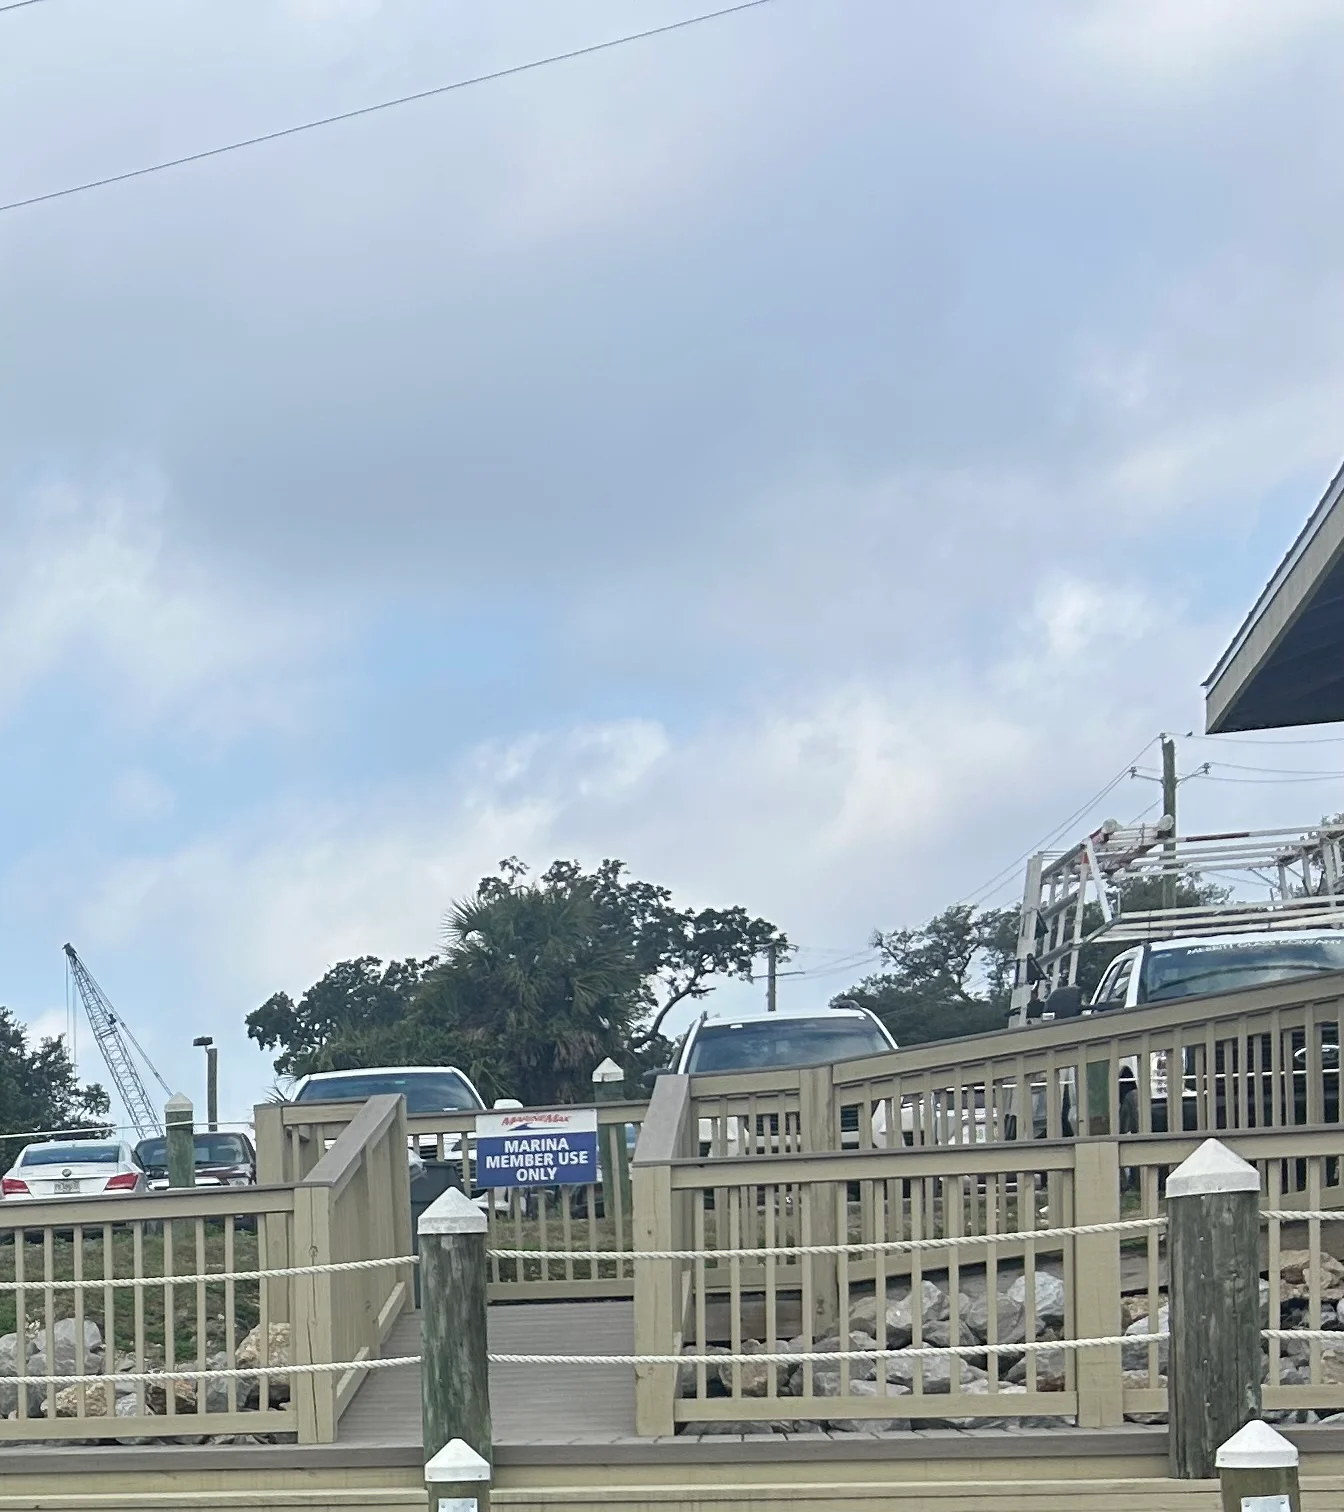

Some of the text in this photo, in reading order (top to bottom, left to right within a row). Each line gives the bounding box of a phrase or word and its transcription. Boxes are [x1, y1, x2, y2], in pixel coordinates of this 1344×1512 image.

[504, 1137, 570, 1154] MARINA
[485, 1150, 589, 1169] MEMBER USE
[515, 1167, 558, 1182] ONLY
